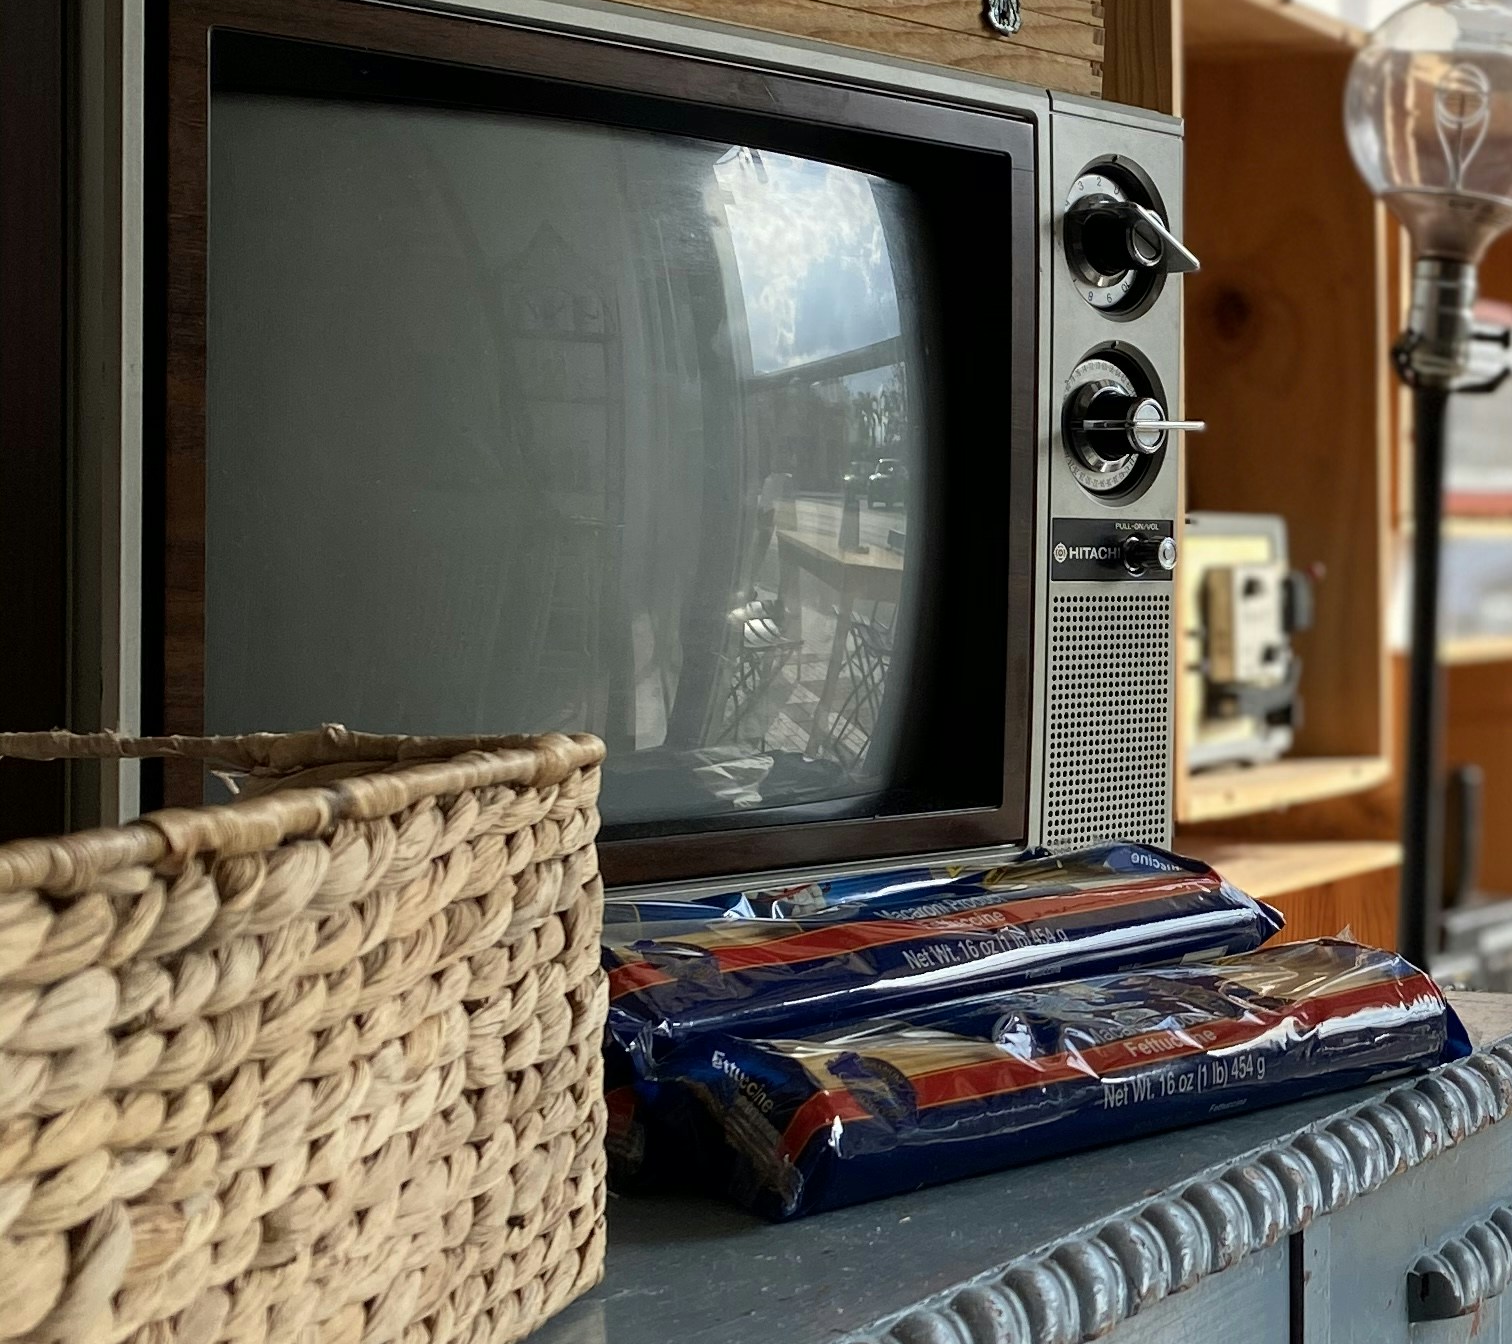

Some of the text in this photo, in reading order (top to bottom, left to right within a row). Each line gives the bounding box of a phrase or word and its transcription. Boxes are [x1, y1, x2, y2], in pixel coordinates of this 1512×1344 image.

[1077, 180, 1085, 191] 3
[1096, 176, 1102, 187] 2
[1087, 291, 1094, 302] 8
[1069, 546, 1121, 560] HITACHI
[902, 949, 935, 970] Net
[958, 939, 980, 958] 16
[980, 940, 1000, 956] oz
[1031, 927, 1057, 944] 454
[1103, 1054, 1266, 1110] Net Wt. 16 oz (1 lb) 454 g
